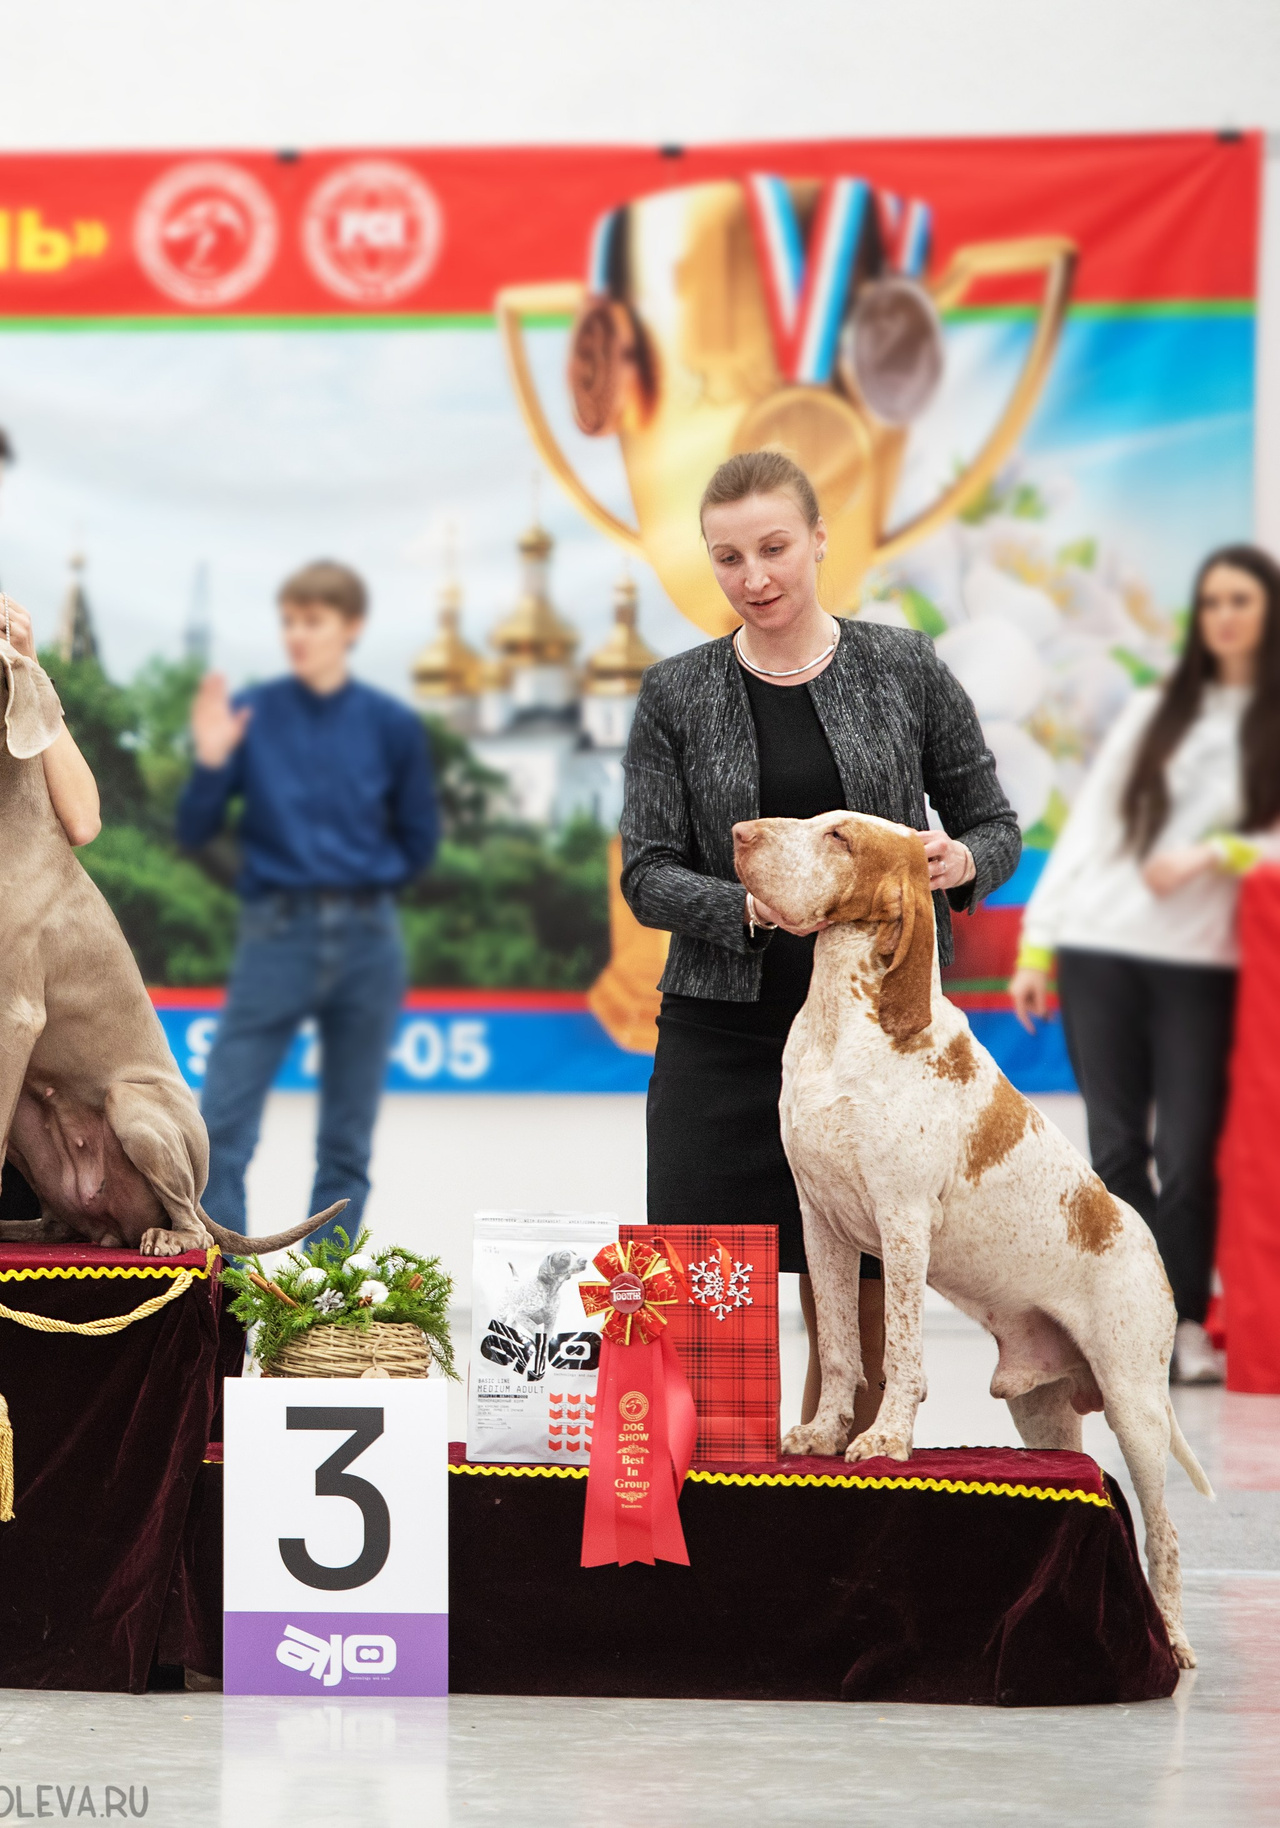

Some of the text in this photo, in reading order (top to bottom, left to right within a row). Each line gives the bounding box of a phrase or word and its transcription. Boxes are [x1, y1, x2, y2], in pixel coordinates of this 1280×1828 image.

[477, 1385, 544, 1394] MEDIUM ADULT
[623, 1423, 644, 1431] DOG
[618, 1433, 649, 1442] SHOW
[621, 1455, 644, 1465] Best
[627, 1467, 638, 1476] In
[614, 1478, 650, 1490] Group
[278, 1407, 391, 1591] 3
